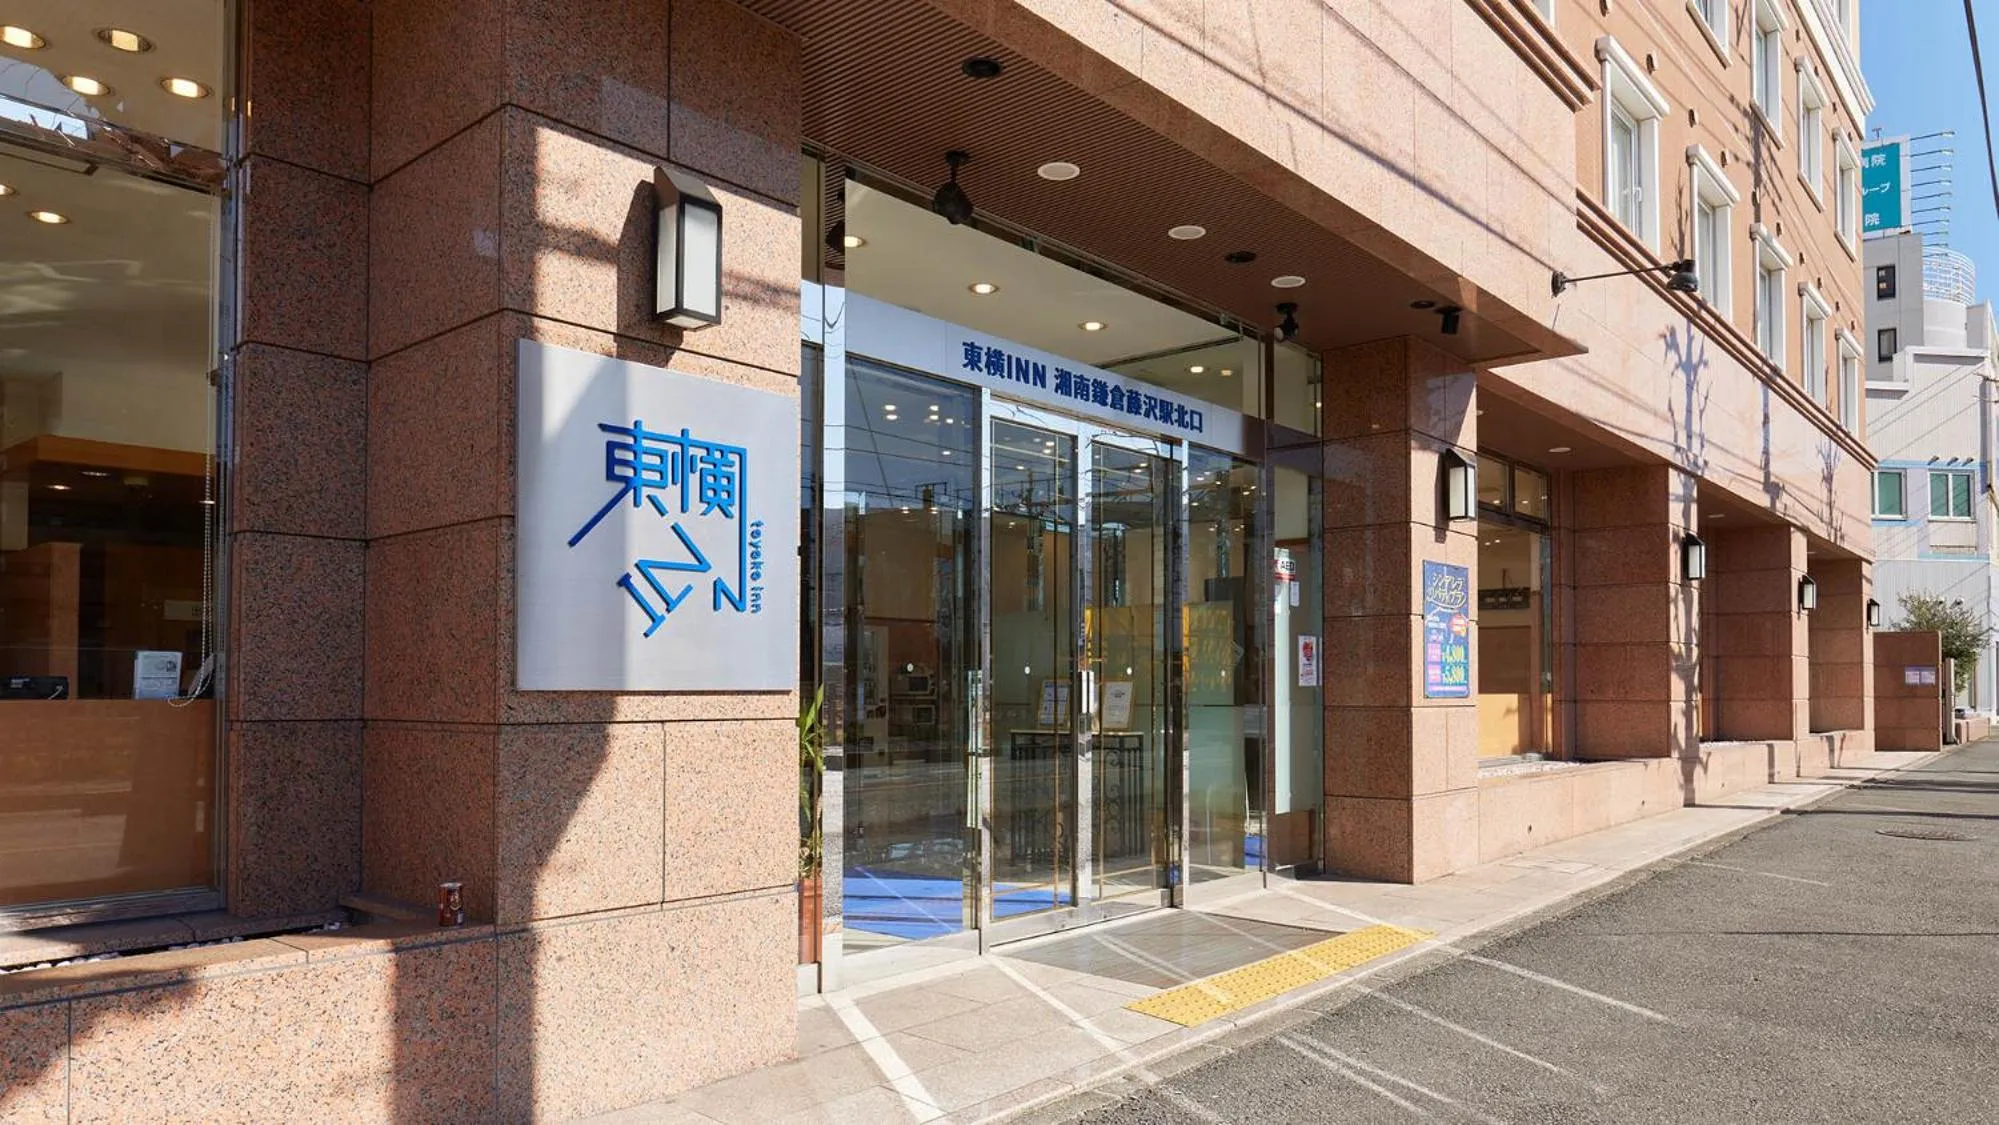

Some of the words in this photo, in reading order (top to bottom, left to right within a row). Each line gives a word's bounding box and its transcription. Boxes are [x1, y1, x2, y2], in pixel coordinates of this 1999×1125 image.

[962, 341, 1047, 389] 東横INN
[1054, 367, 1204, 433] 湘南鎌倉藤沢駅北口
[748, 520, 764, 582] toyoko
[750, 586, 764, 614] inn
